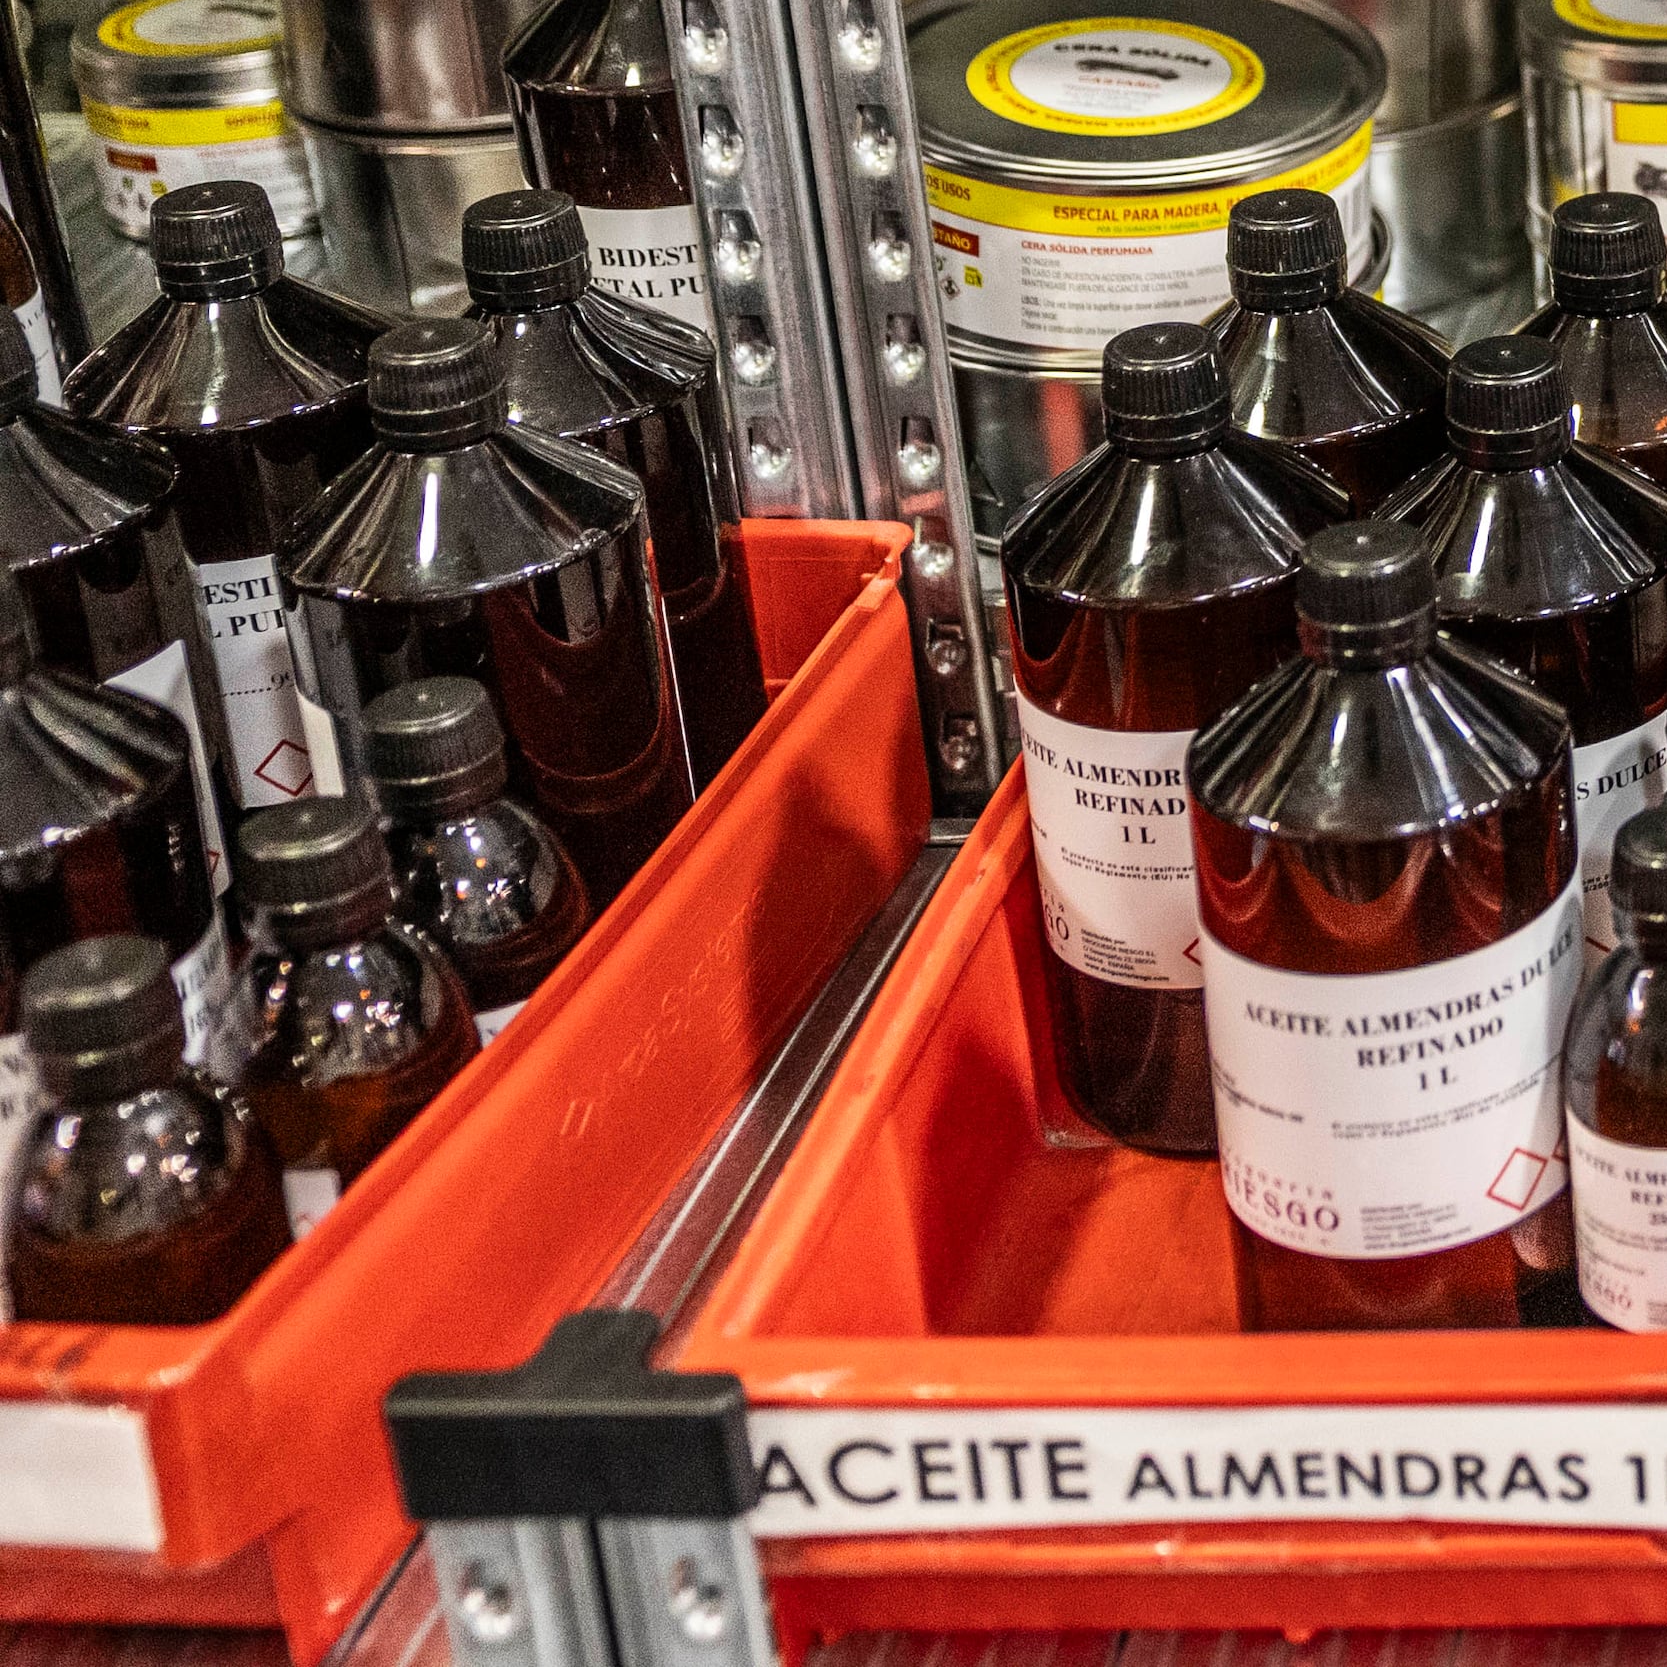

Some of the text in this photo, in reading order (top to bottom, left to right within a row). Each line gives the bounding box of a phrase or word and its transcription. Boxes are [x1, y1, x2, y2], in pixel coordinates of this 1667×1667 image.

[1053, 202, 1222, 222] ESPECIAL PARA MADERA,
[597, 244, 698, 268] BIDEST
[1021, 240, 1153, 256] CERA SÓLIDA PERFUMADA
[1062, 756, 1183, 788] ALMENDR
[1074, 787, 1186, 816] REFINAD
[1140, 825, 1156, 845] L
[1244, 1001, 1332, 1037] ACEITE
[1341, 981, 1514, 1036] ALMENDRAS
[1356, 1016, 1504, 1069] REFINADO
[756, 1437, 1090, 1509] ACEITE
[1127, 1449, 1591, 1505] ALMENDRAS
